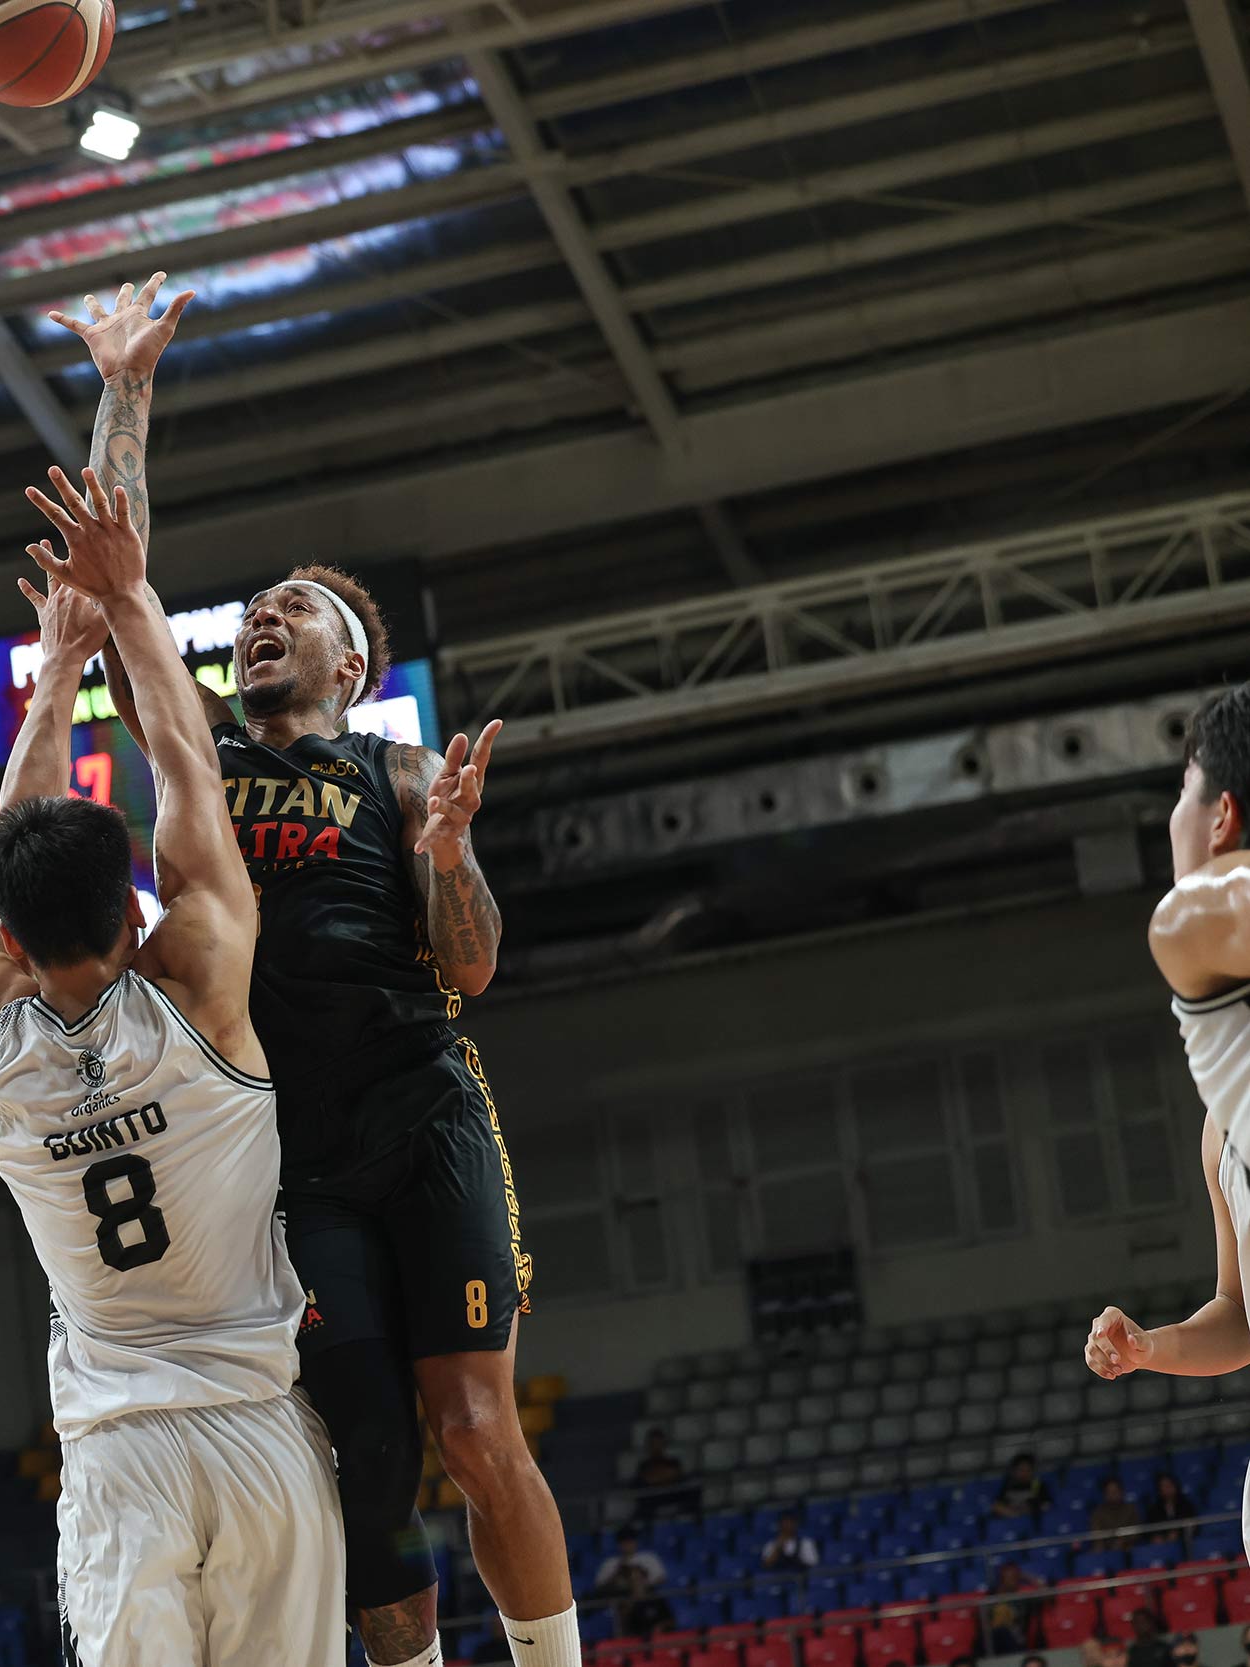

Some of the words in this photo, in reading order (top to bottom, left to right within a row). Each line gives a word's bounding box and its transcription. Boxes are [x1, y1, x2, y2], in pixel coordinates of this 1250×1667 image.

[232, 821, 341, 860] TRA
[43, 1101, 168, 1161] GUINTO
[81, 1153, 171, 1273] 8
[465, 1279, 488, 1329] 8
